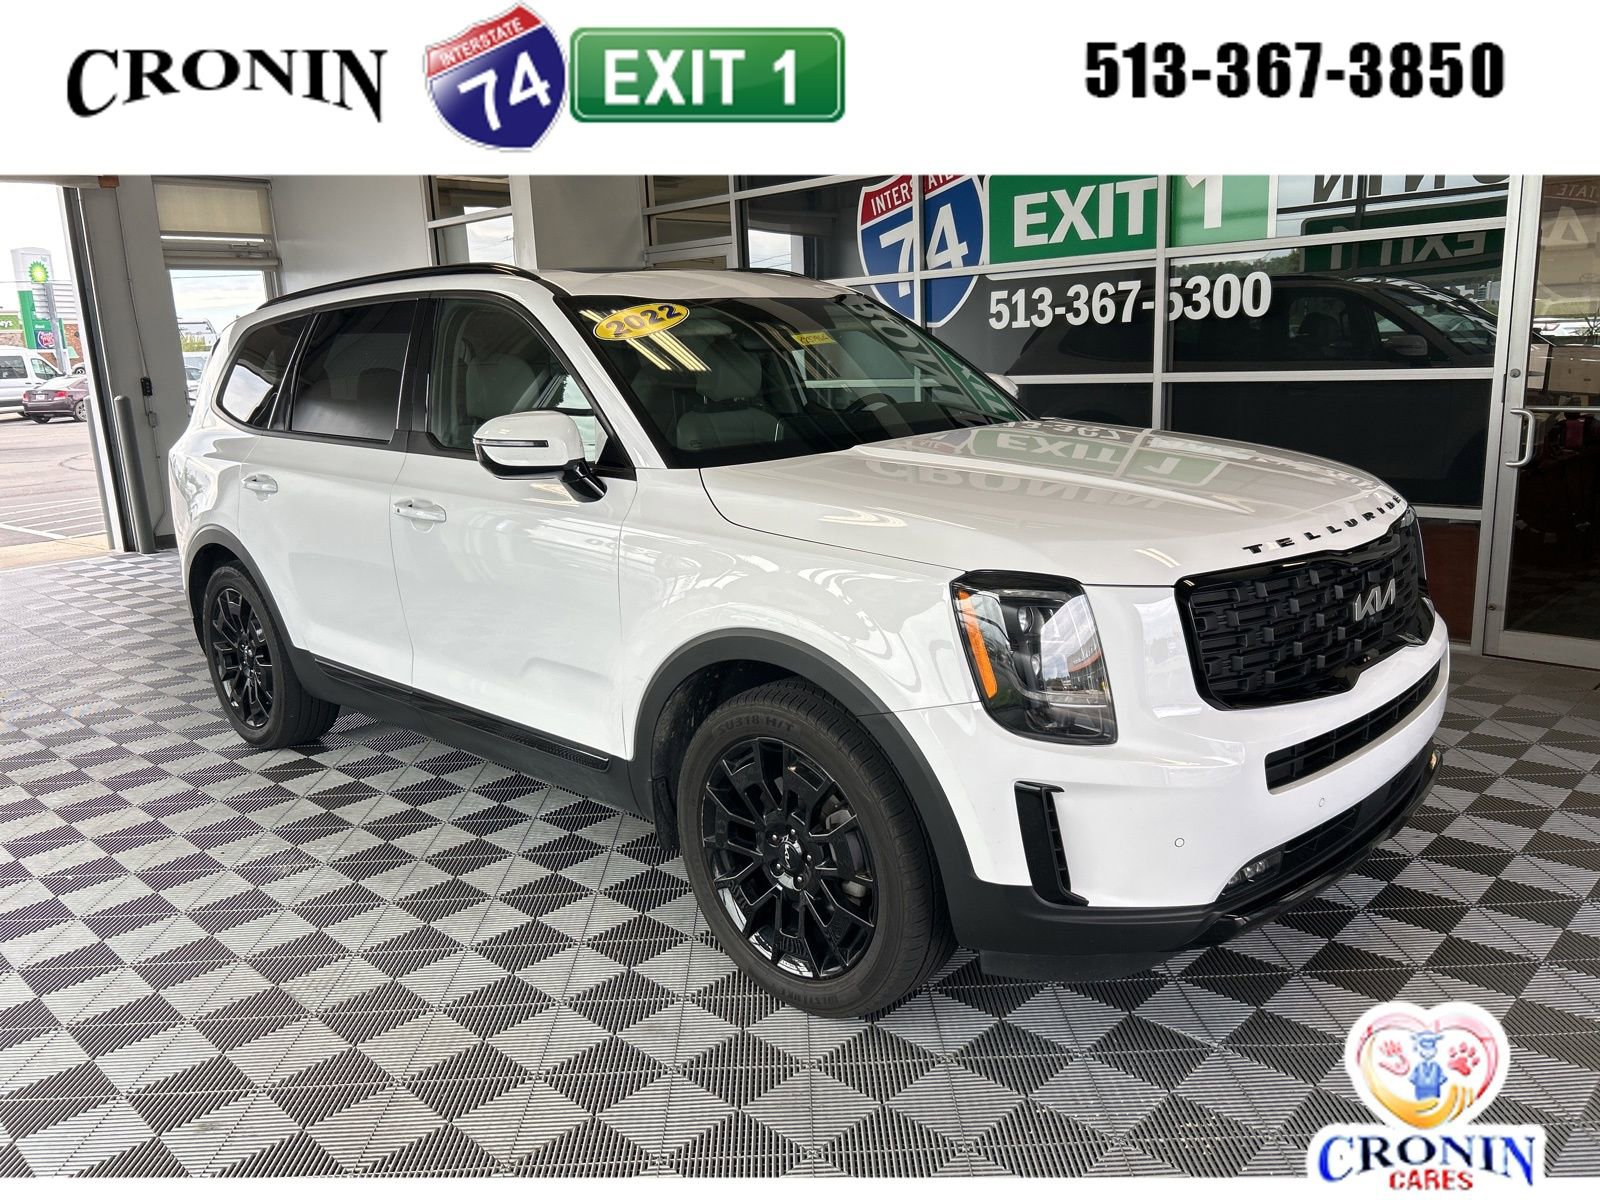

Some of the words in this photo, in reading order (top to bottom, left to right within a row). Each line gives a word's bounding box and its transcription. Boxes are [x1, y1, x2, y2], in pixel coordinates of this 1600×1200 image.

[1014, 177, 1157, 247] EXIT
[1185, 175, 1222, 229] 1
[879, 203, 968, 298] 74
[606, 305, 682, 337] 2022
[988, 271, 1272, 330] 513-367-5300
[1242, 495, 1402, 554] TELLURIDE
